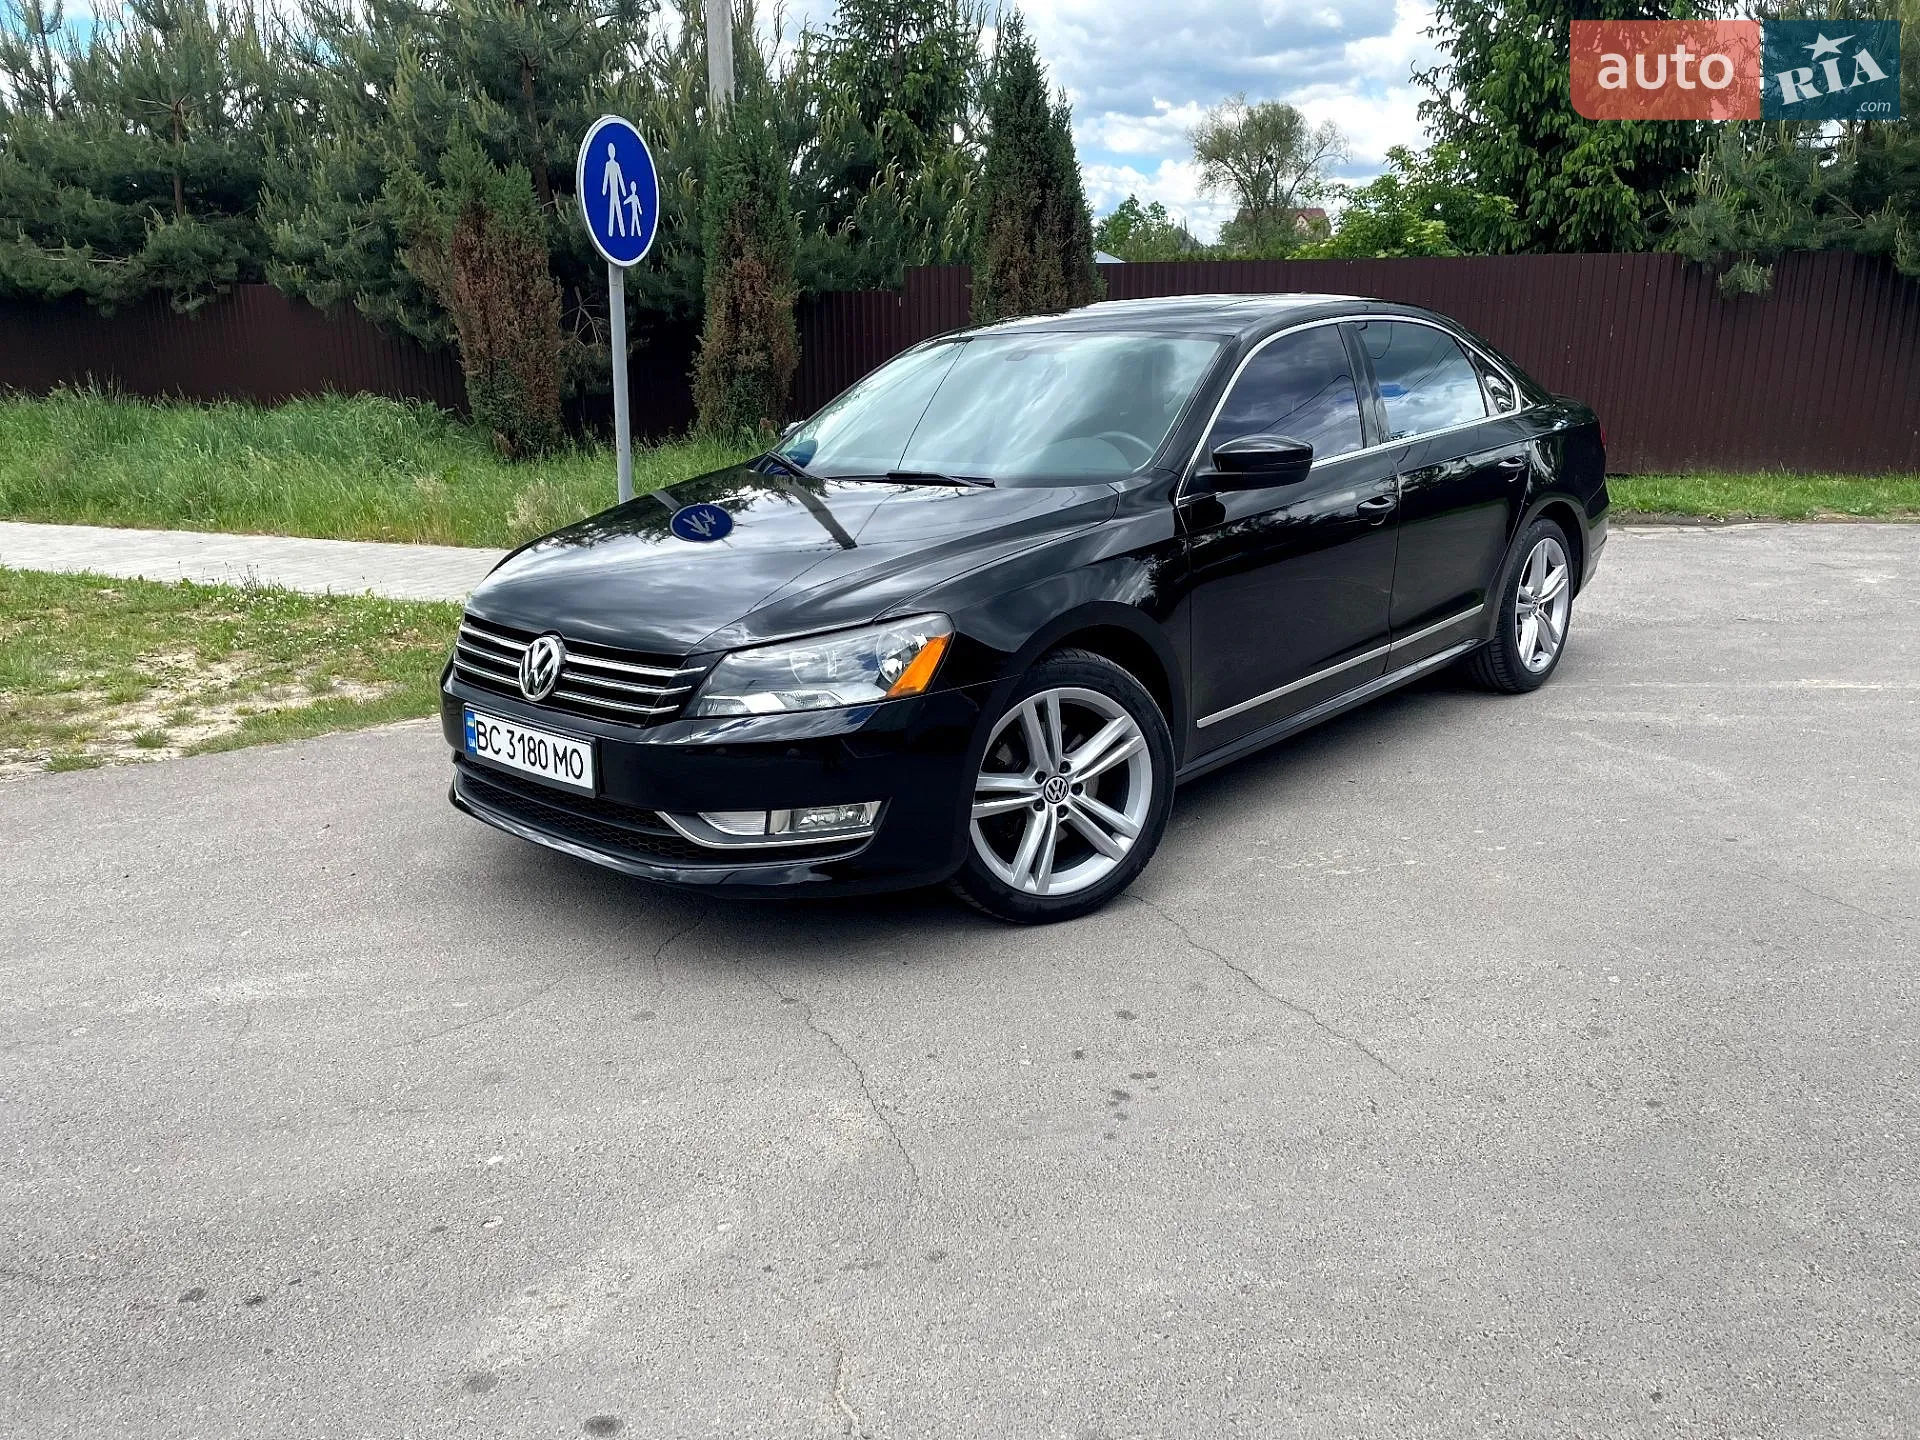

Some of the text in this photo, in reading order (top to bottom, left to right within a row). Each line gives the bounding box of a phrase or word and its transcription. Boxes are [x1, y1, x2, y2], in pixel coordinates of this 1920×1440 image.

[476, 720, 584, 780] BC 3180 MO
